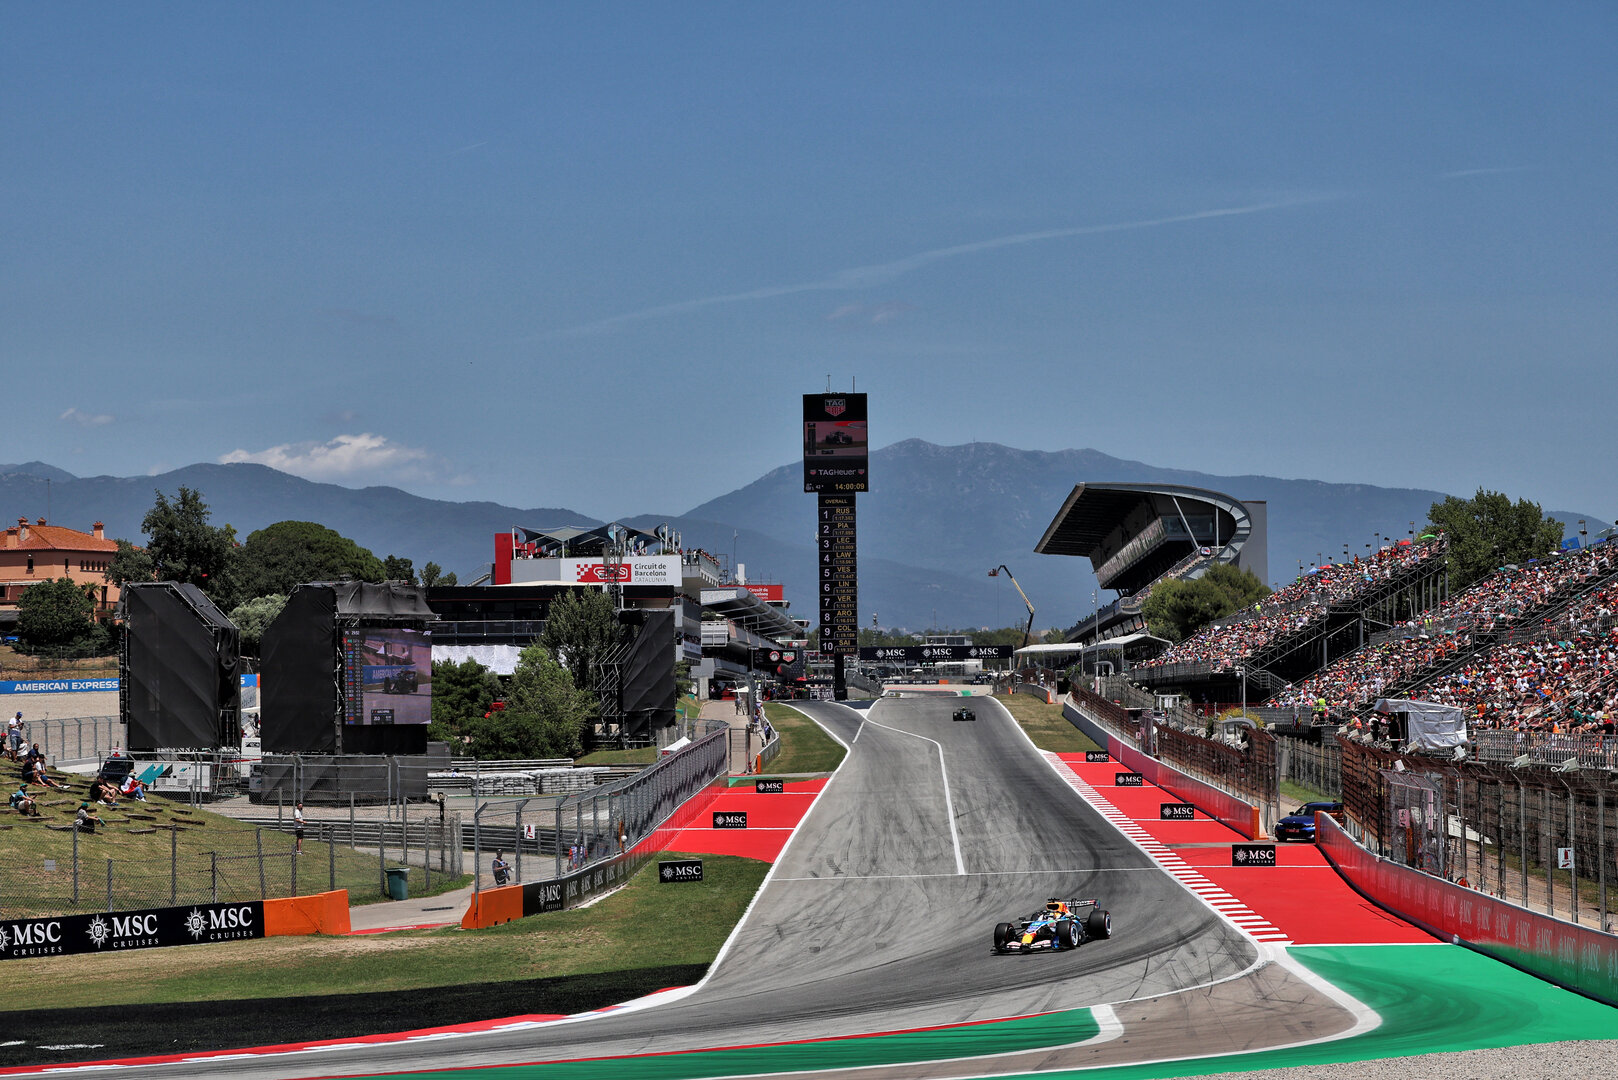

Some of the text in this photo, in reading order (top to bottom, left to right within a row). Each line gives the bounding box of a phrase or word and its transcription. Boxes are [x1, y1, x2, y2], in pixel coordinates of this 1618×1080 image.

[823, 510, 828, 519] 1
[823, 525, 829, 534] 2
[823, 539, 830, 548] 3
[823, 554, 830, 563] 4
[824, 568, 830, 577] 5
[824, 583, 830, 592] 6
[824, 598, 830, 607] 7
[824, 613, 830, 621] 8
[824, 627, 831, 636] 9
[822, 642, 833, 650] 10
[979, 647, 999, 655] MSC
[14, 681, 118, 692] AMERICAN EXPRESS
[1173, 807, 1193, 815] MSC
[725, 815, 746, 824] MSC
[1248, 849, 1275, 860] MSC
[676, 865, 702, 876] MSC
[545, 884, 562, 902] MSC
[208, 907, 253, 930] MSC
[112, 914, 158, 938] MSC
[12, 922, 62, 946] MSC
[209, 930, 255, 941] CRUISES
[1519, 920, 1531, 948] MSC
[113, 938, 160, 949] CRUISES
[1540, 928, 1553, 956] MSC
[13, 946, 64, 957] CRUISES
[1563, 936, 1576, 965] MSC
[1587, 942, 1601, 972] MSC
